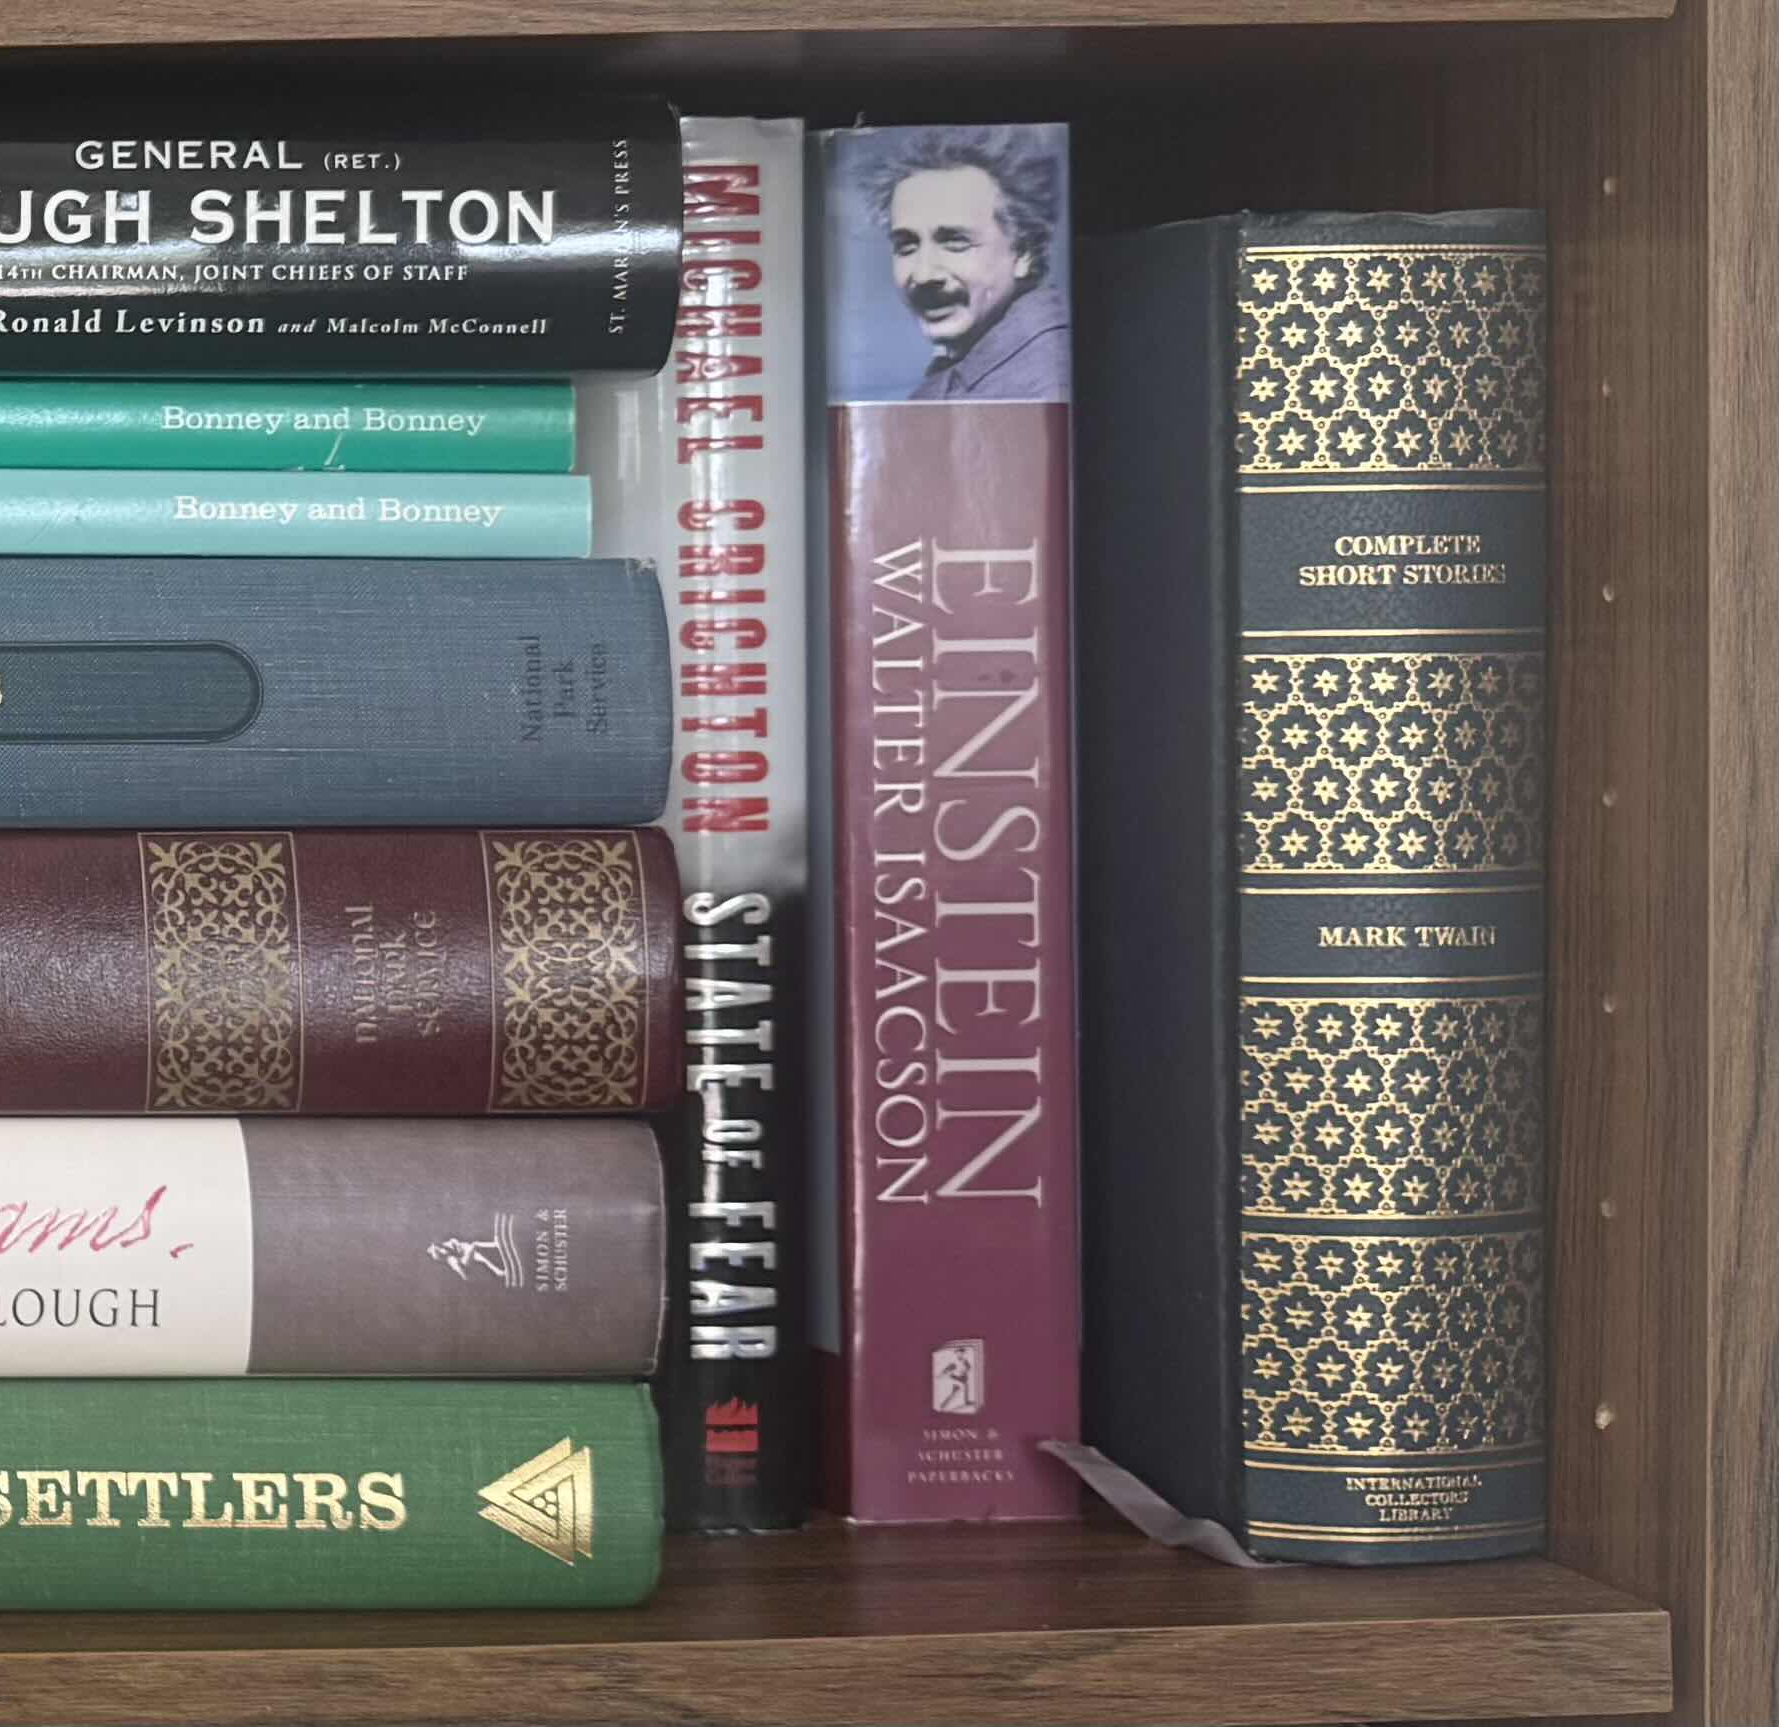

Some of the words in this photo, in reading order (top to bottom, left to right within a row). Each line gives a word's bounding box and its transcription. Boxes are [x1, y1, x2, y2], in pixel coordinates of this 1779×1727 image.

[75, 140, 304, 171] GENERAL
[322, 151, 402, 172] (RET.)
[611, 138, 631, 195] PRESS
[190, 189, 557, 247] SHELTON
[50, 264, 186, 284] CHAIRMAN,
[192, 264, 266, 284] JOINT
[272, 264, 356, 281] CHIEFS
[363, 264, 395, 281] OF
[402, 264, 471, 281] STAFF
[115, 309, 267, 336] Levinson
[277, 317, 318, 336] and
[326, 317, 420, 336] Malcolm
[428, 317, 549, 337] McConnell
[608, 308, 626, 335] ST.
[675, 163, 764, 465] MICHAEL
[161, 405, 283, 436] Bonney
[293, 408, 351, 433] and
[362, 408, 487, 438] Bonney
[173, 495, 298, 526] Bonney
[307, 498, 366, 523] and
[377, 498, 504, 528] Bonney
[1334, 535, 1482, 558] COMPLETE
[1299, 564, 1396, 588] SHORT
[520, 635, 542, 743] National
[677, 498, 770, 834] CRICHTON
[870, 538, 927, 820] WALTER
[929, 537, 1044, 1209] EINSTEIN
[1318, 925, 1407, 950] MARK
[1415, 924, 1499, 949] TWAIN
[873, 850, 929, 1205] ISAACSON
[536, 1232, 551, 1293] SIMON
[552, 1207, 569, 1293] SCHUSTER
[688, 1201, 778, 1363] FEAR
